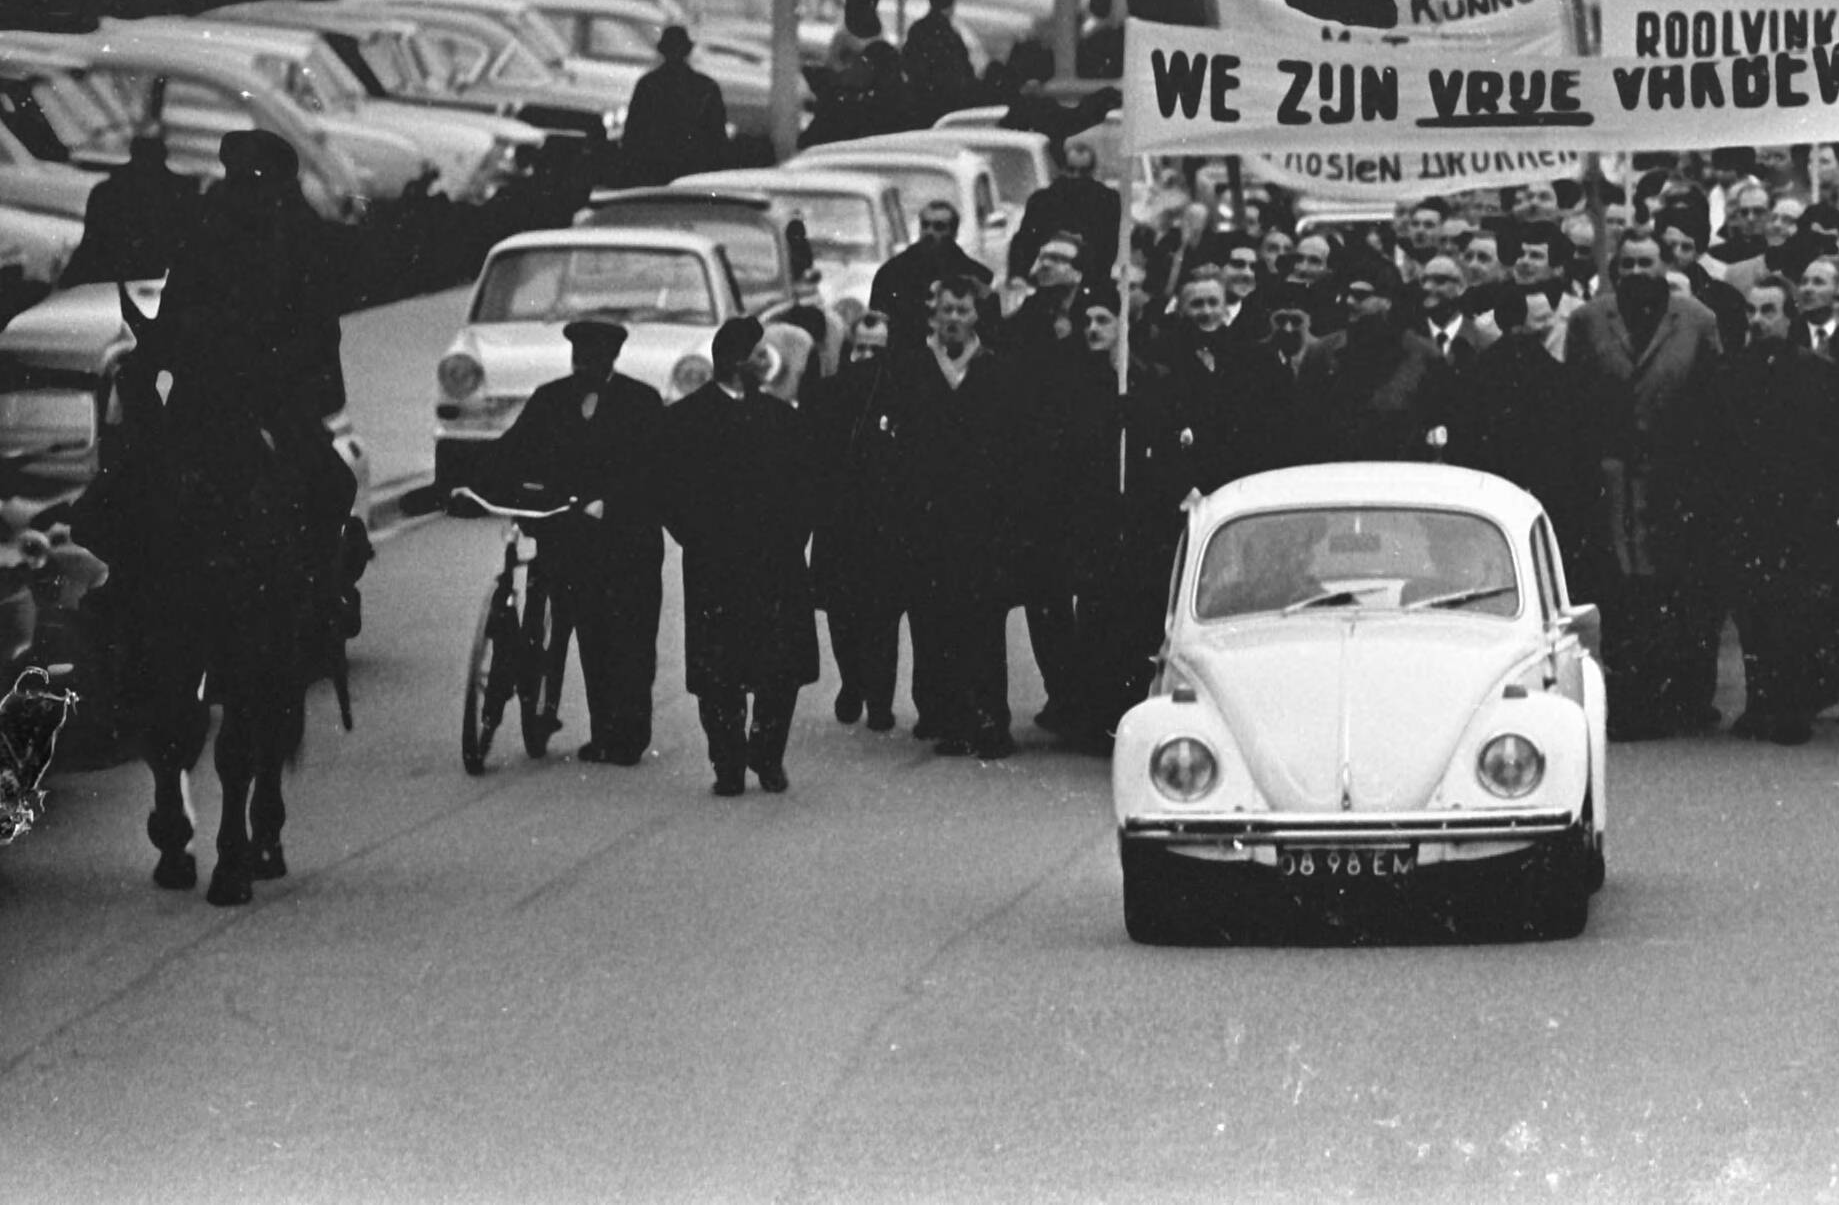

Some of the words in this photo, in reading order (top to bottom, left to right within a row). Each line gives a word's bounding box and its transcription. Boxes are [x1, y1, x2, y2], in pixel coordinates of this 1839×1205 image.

[1635, 8, 1838, 58] ROOLVINK
[1150, 48, 1241, 123] WE
[1276, 59, 1399, 125] ZIJN
